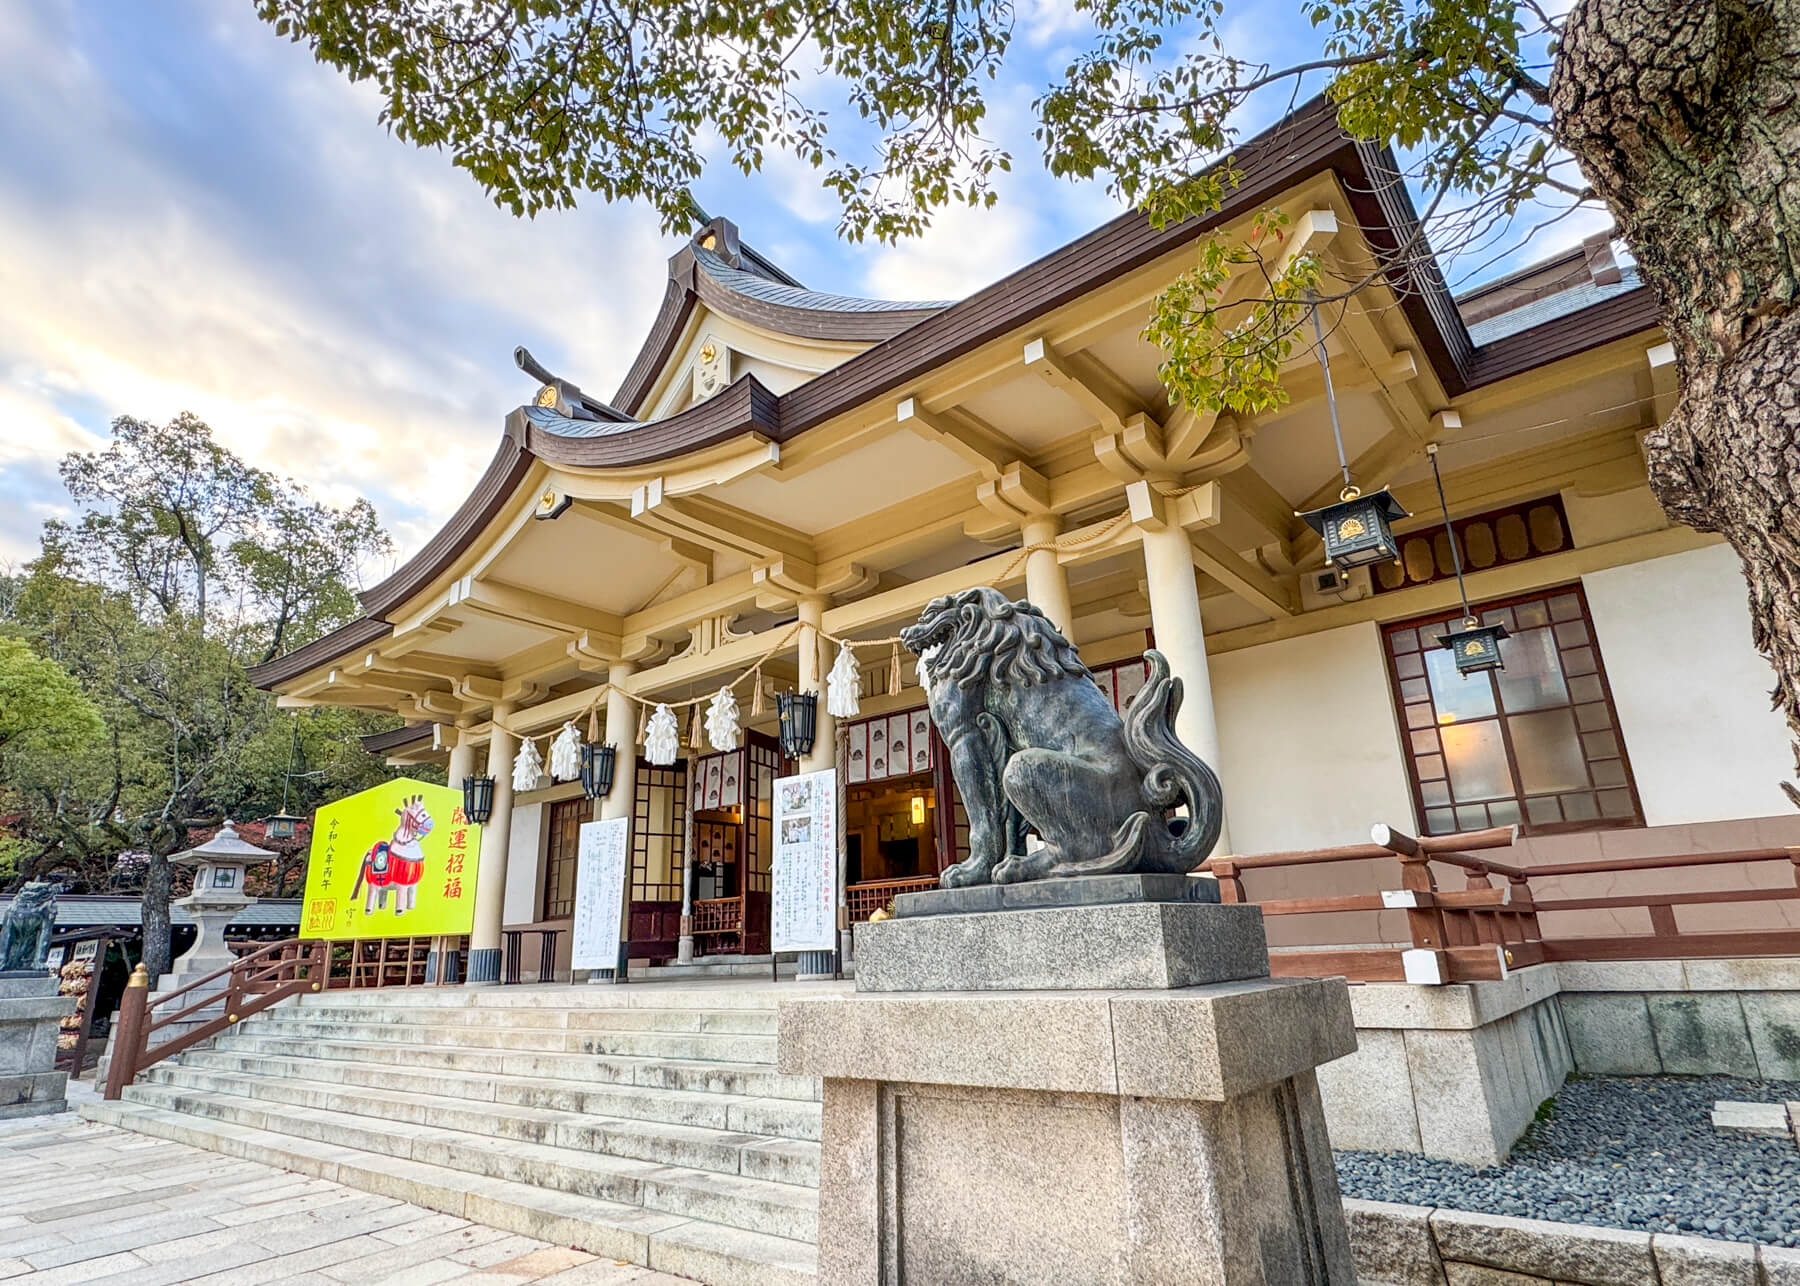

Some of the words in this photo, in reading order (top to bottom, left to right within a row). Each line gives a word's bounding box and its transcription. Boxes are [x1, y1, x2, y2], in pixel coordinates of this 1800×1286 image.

[321, 817, 340, 891] 令和八年丙午
